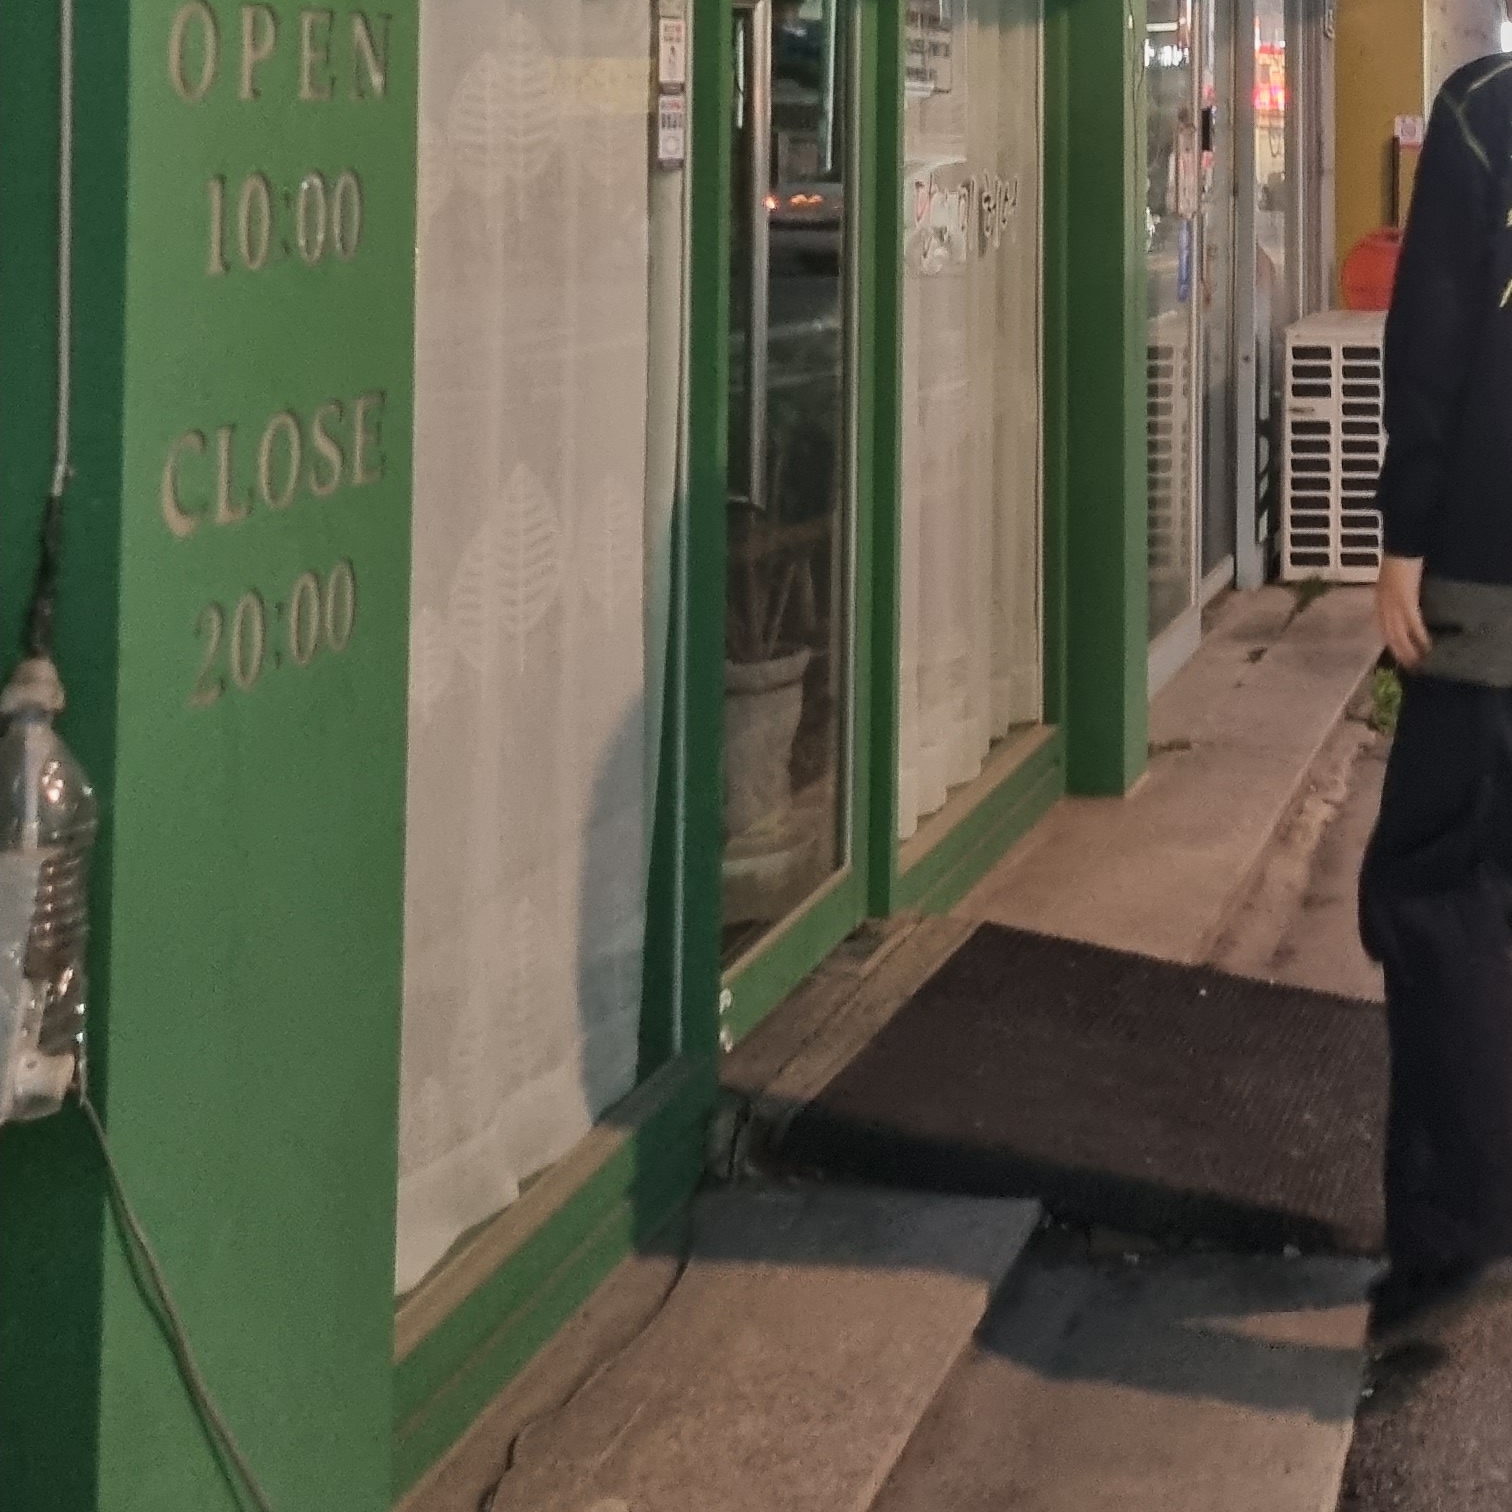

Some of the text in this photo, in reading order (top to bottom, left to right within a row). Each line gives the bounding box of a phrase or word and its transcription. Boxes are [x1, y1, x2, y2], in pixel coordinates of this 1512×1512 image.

[205, 168, 364, 276] 10:00
[160, 390, 387, 542] CLOSE
[187, 556, 356, 710] 20:00
